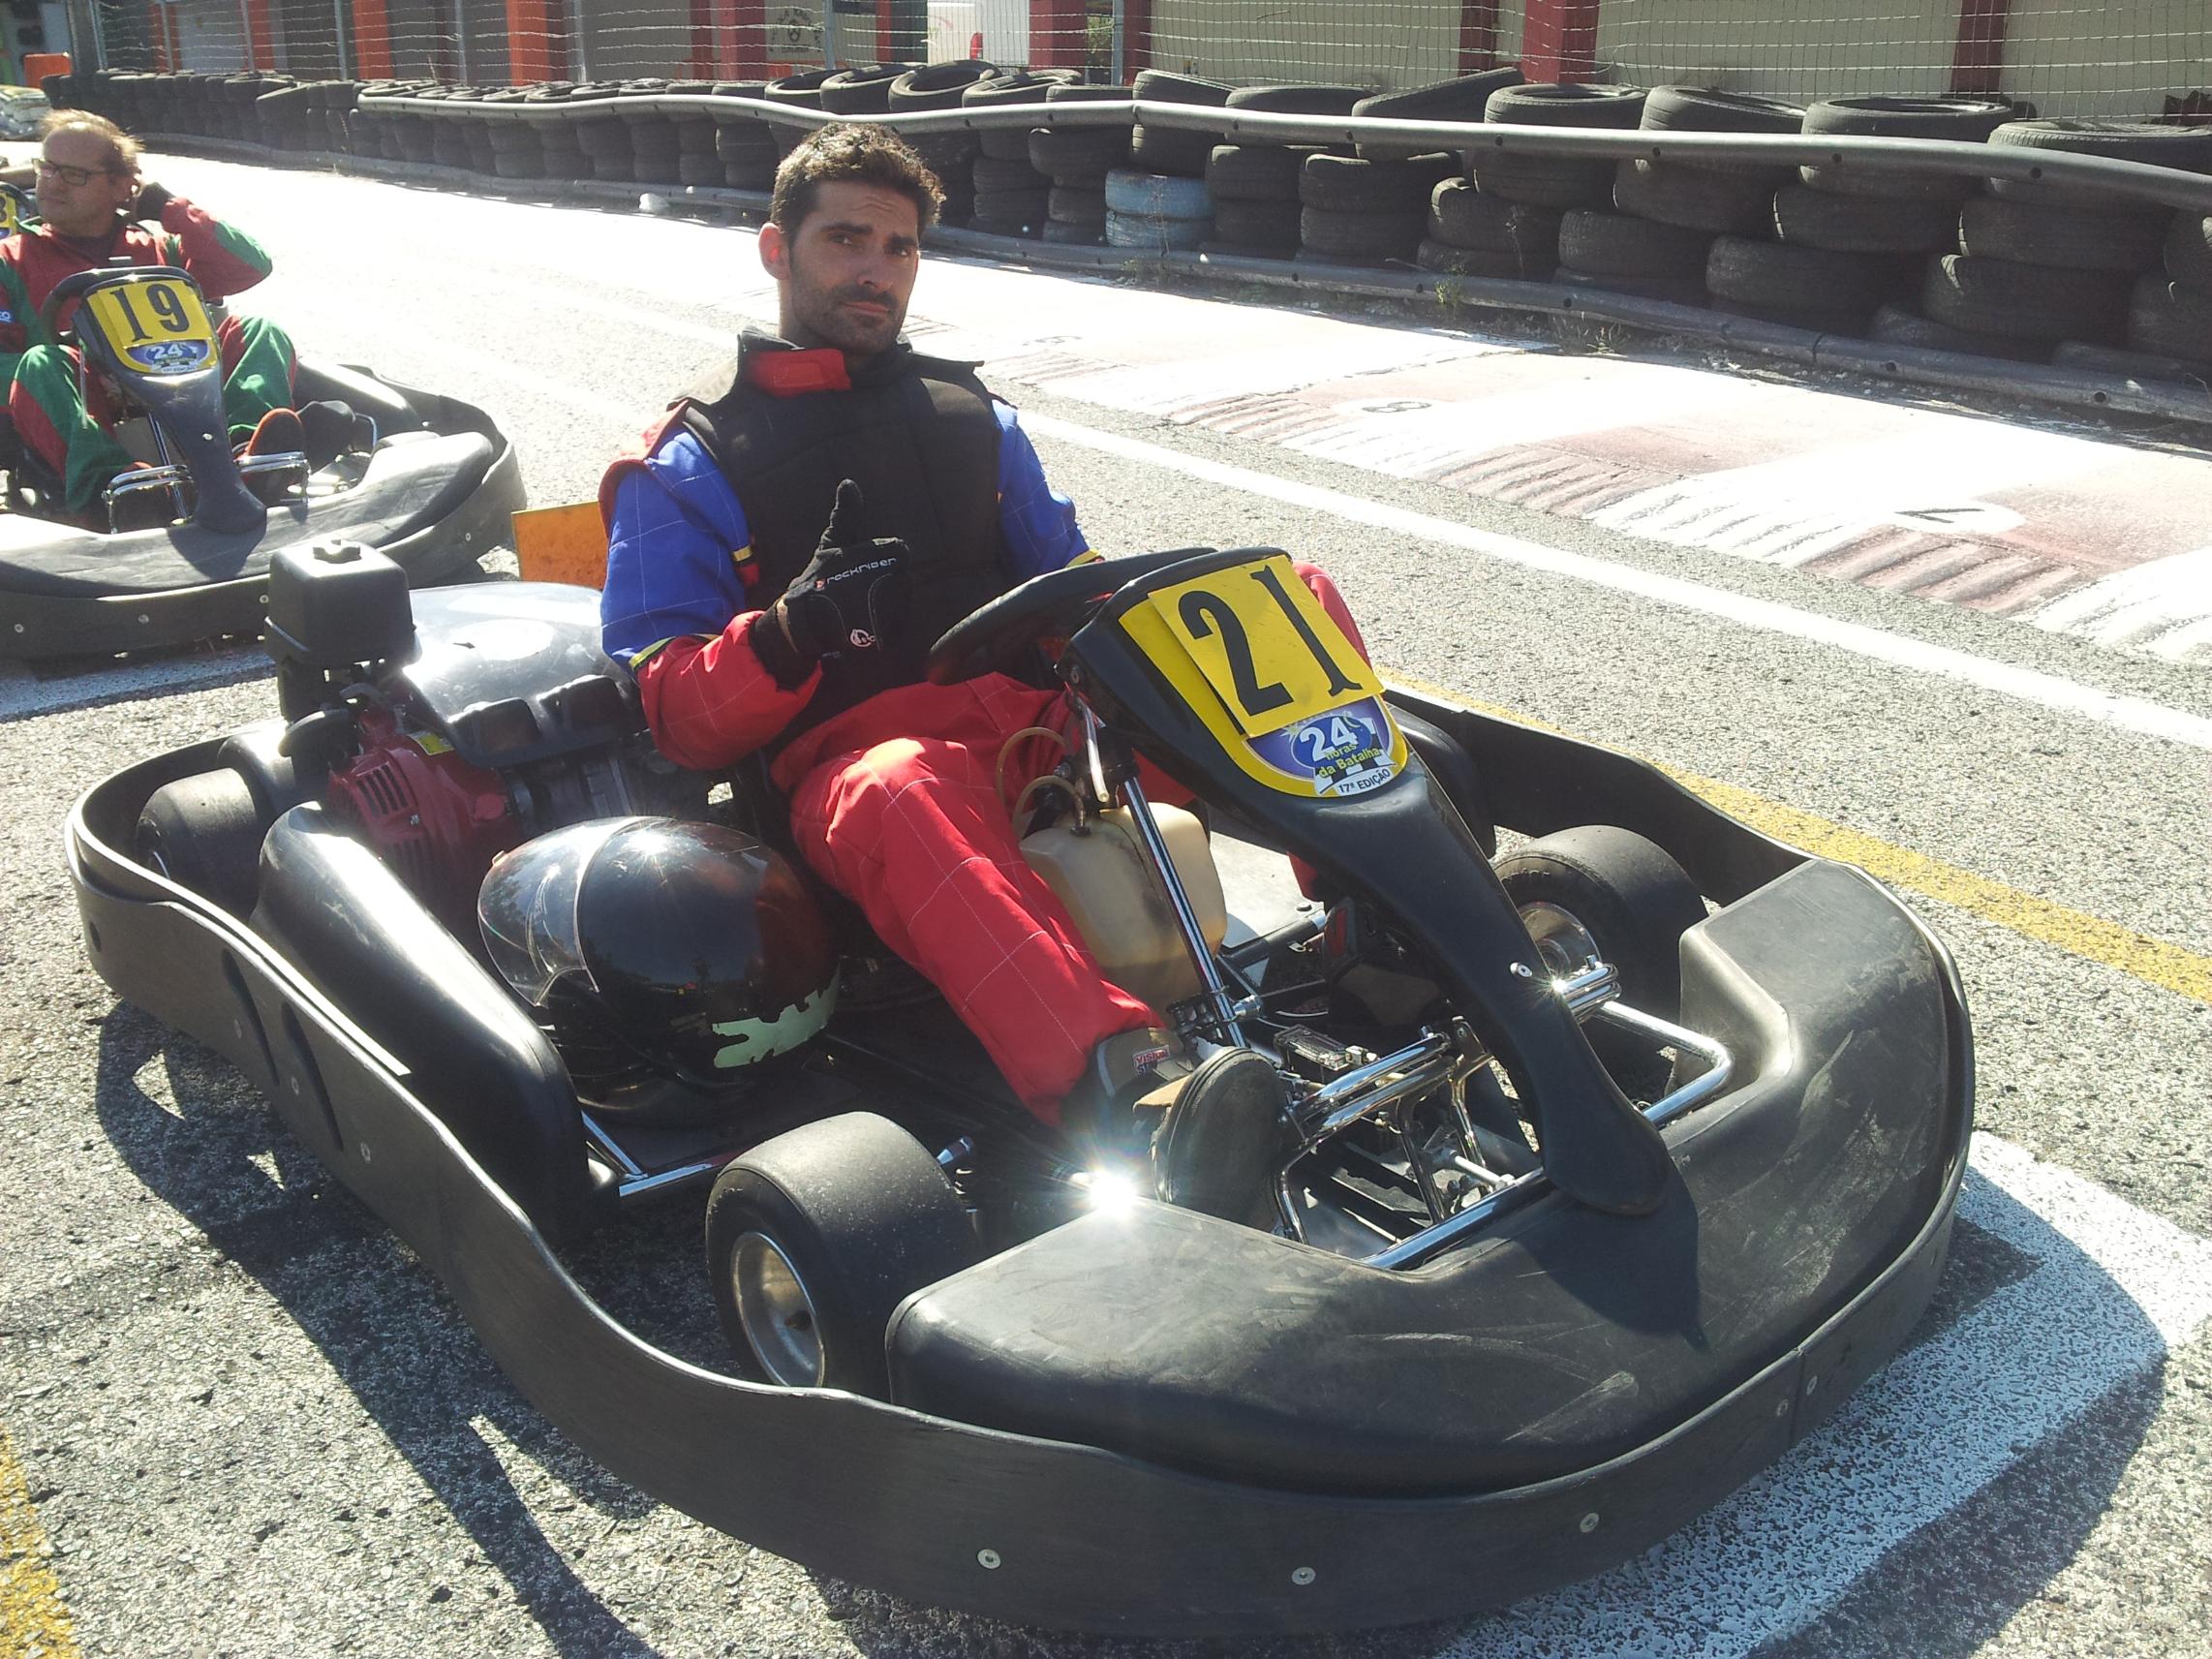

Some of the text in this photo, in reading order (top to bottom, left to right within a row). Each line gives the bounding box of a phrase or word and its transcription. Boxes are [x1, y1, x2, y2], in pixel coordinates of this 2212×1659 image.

[109, 284, 190, 342] 19
[150, 343, 183, 359] 24
[1178, 565, 1363, 716] 21
[1300, 717, 1358, 761] 24
[1318, 748, 1380, 778] da Batalha
[1357, 768, 1391, 790] EDIÇÃO
